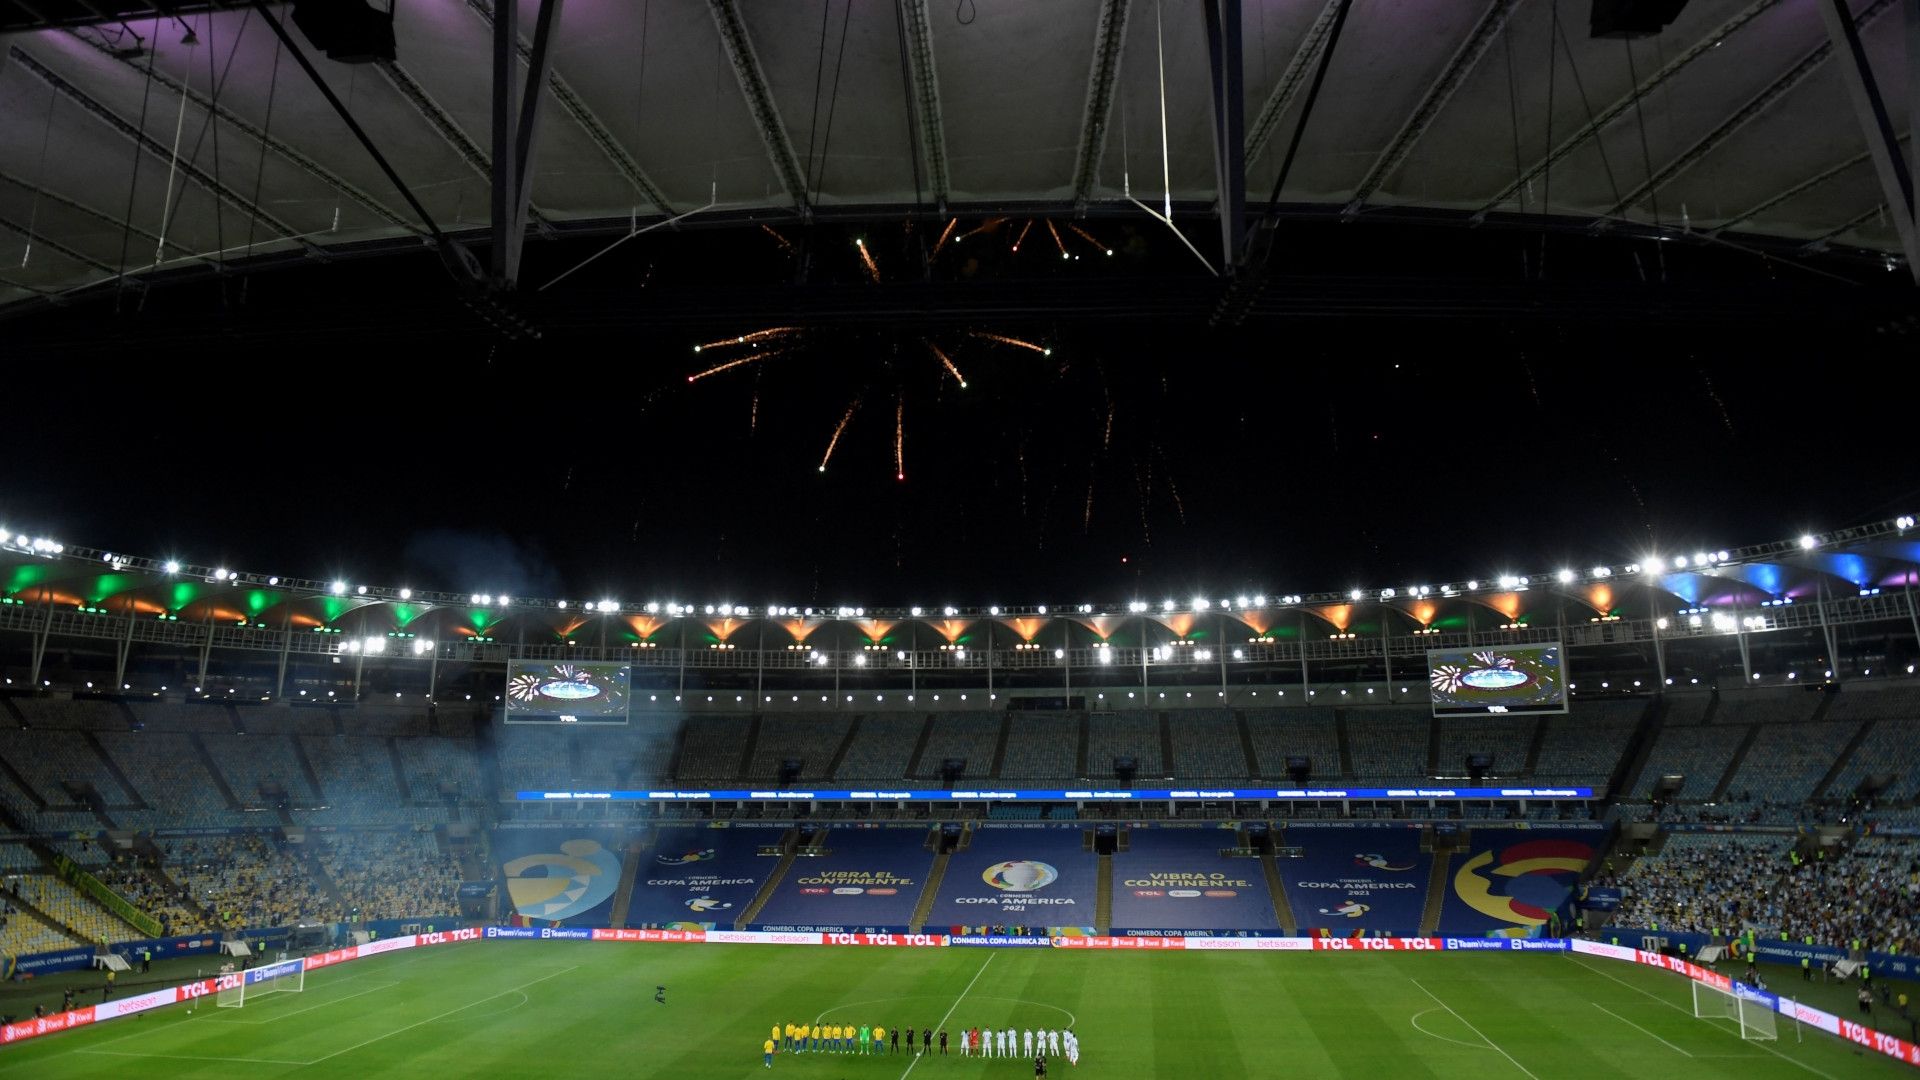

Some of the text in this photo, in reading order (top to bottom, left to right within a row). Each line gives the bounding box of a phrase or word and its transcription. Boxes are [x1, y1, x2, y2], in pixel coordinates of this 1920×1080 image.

[1124, 879, 1252, 887] CONTINENTE.
[421, 928, 478, 945] TCL TCL
[497, 930, 588, 938] TeamViewer TeamViewer
[770, 935, 809, 943] betsson
[828, 934, 934, 946] TCL TCL TCL
[1199, 938, 1298, 947] betsson betsson
[1319, 938, 1435, 949] TCL TCL TCL
[1458, 940, 1566, 949] TeamViewer TeamViewer
[1759, 946, 1793, 957] CONMEBOL
[1794, 950, 1813, 959] COPA
[63, 954, 88, 963] AMERICA
[1638, 950, 1687, 974] TCL TCL
[181, 973, 241, 999] TCL TCL
[118, 996, 158, 1013] betsson
[1842, 1020, 1904, 1060] TCL TCL
